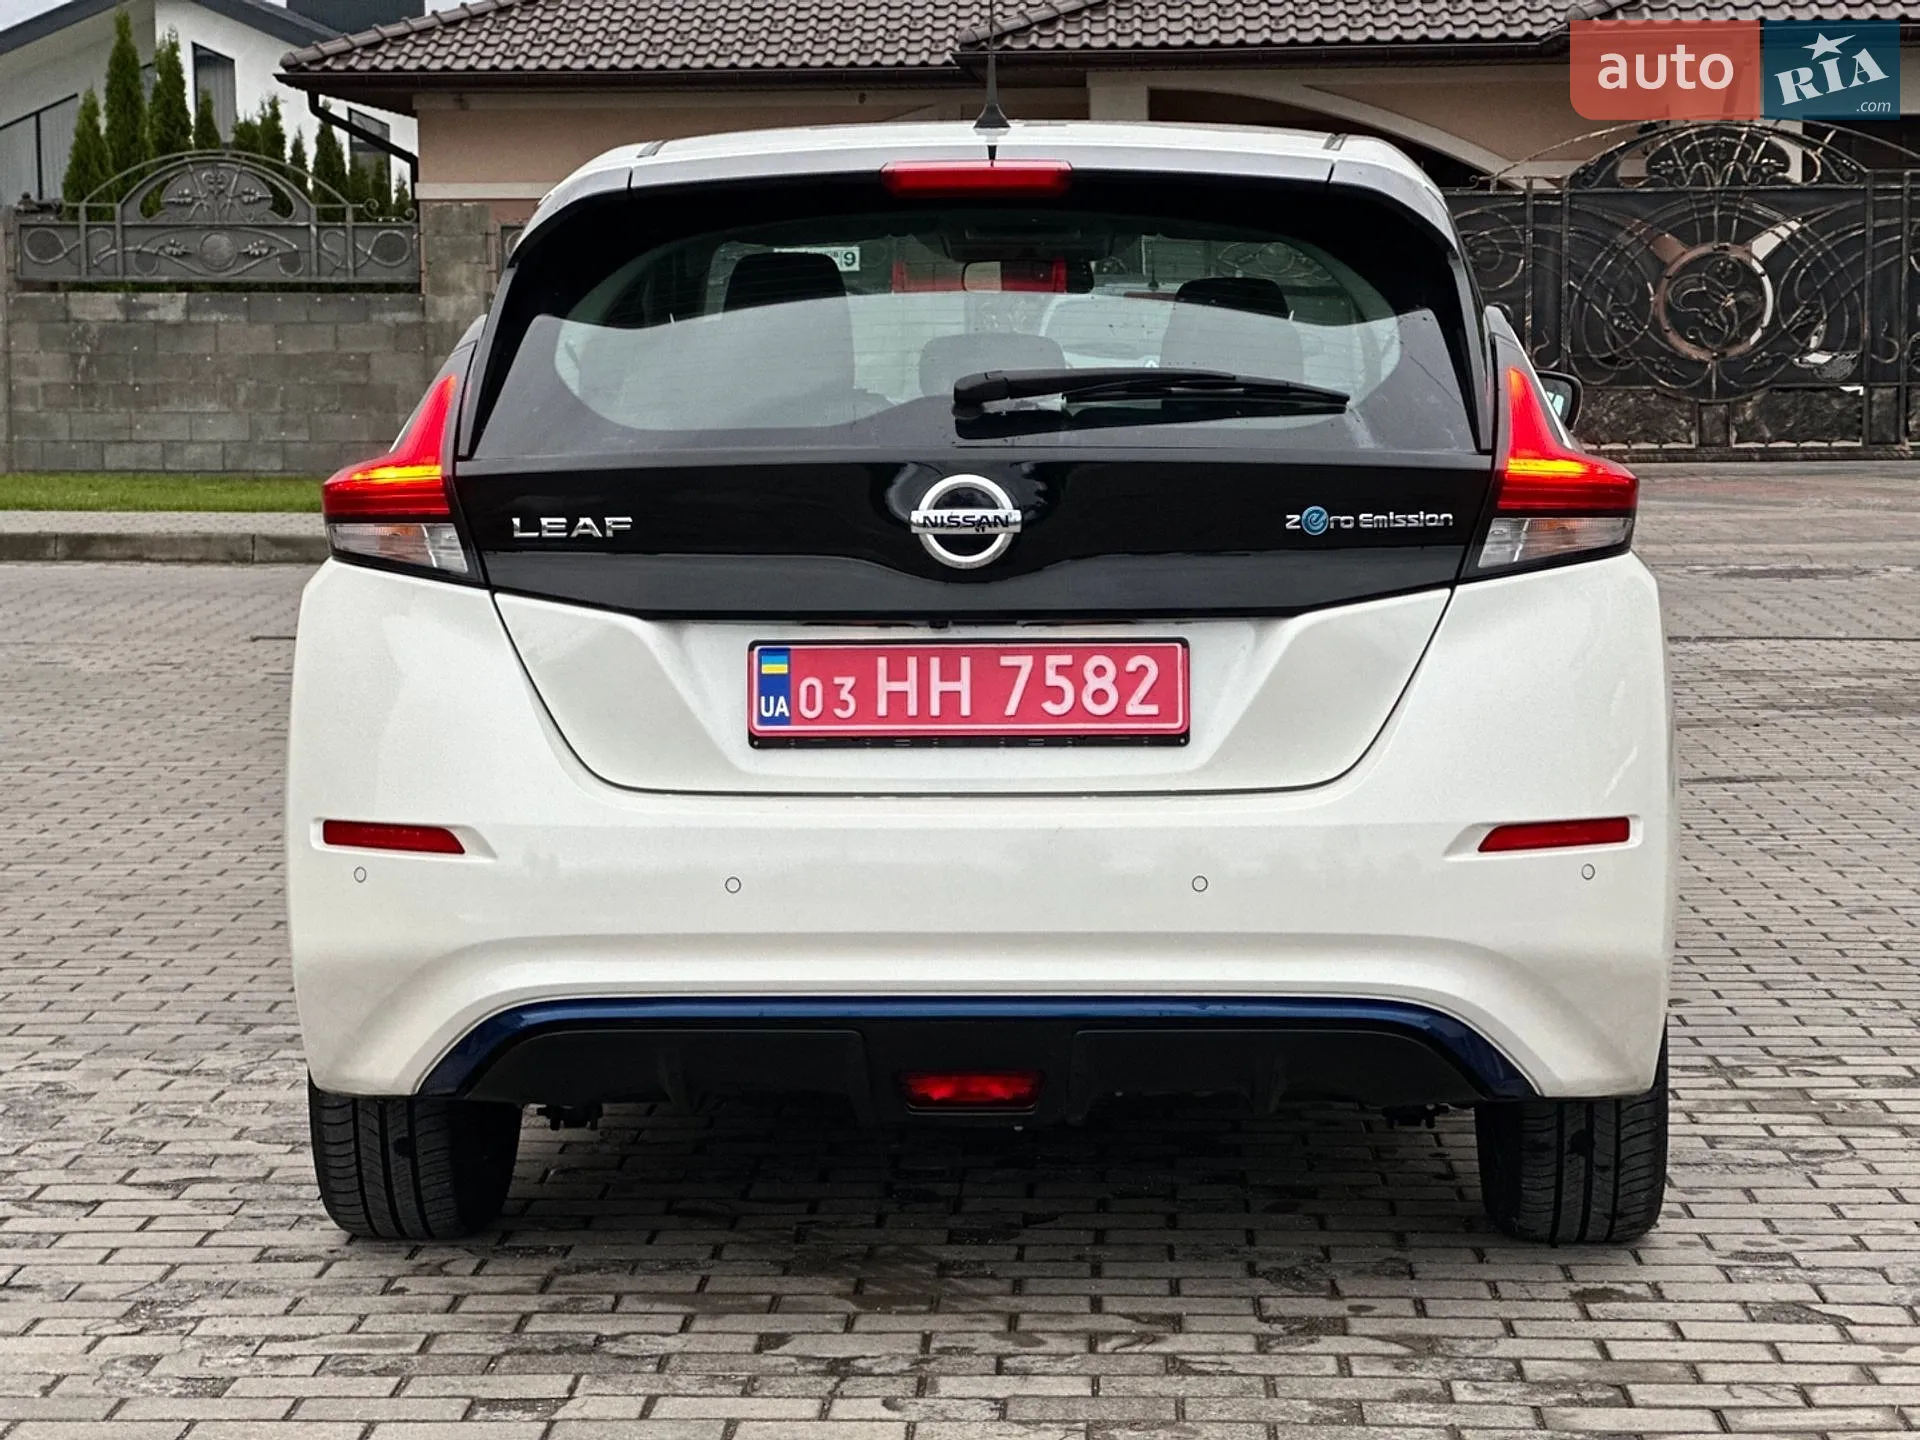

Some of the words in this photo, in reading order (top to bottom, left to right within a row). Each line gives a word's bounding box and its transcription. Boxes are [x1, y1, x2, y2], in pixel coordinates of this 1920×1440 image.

[511, 516, 633, 538] LEAF
[922, 514, 1010, 529] NISSAN
[1358, 511, 1453, 529] Emission
[799, 676, 857, 719] 03
[876, 656, 971, 717] HH
[999, 654, 1160, 717] 7582
[760, 696, 790, 717] UA
